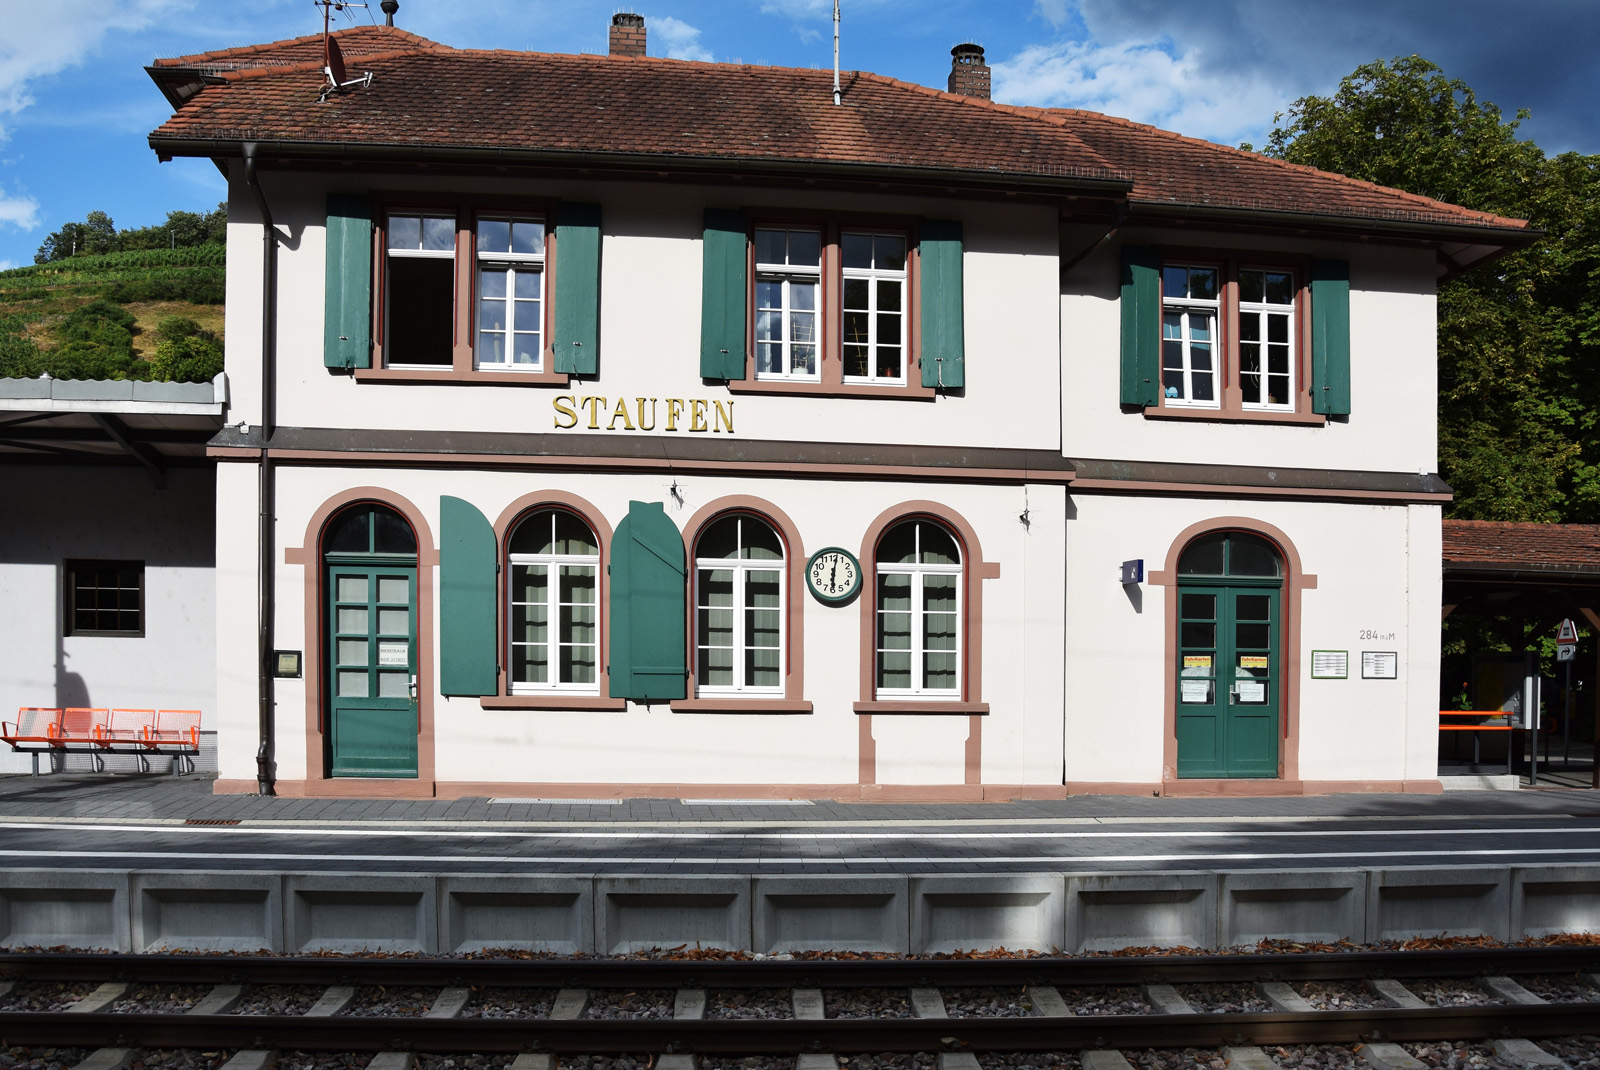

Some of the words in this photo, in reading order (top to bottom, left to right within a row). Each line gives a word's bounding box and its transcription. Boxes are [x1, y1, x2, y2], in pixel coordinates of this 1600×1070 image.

[552, 395, 735, 433] STAUFEN
[845, 562, 850, 570] 2
[1360, 630, 1378, 640] 284
